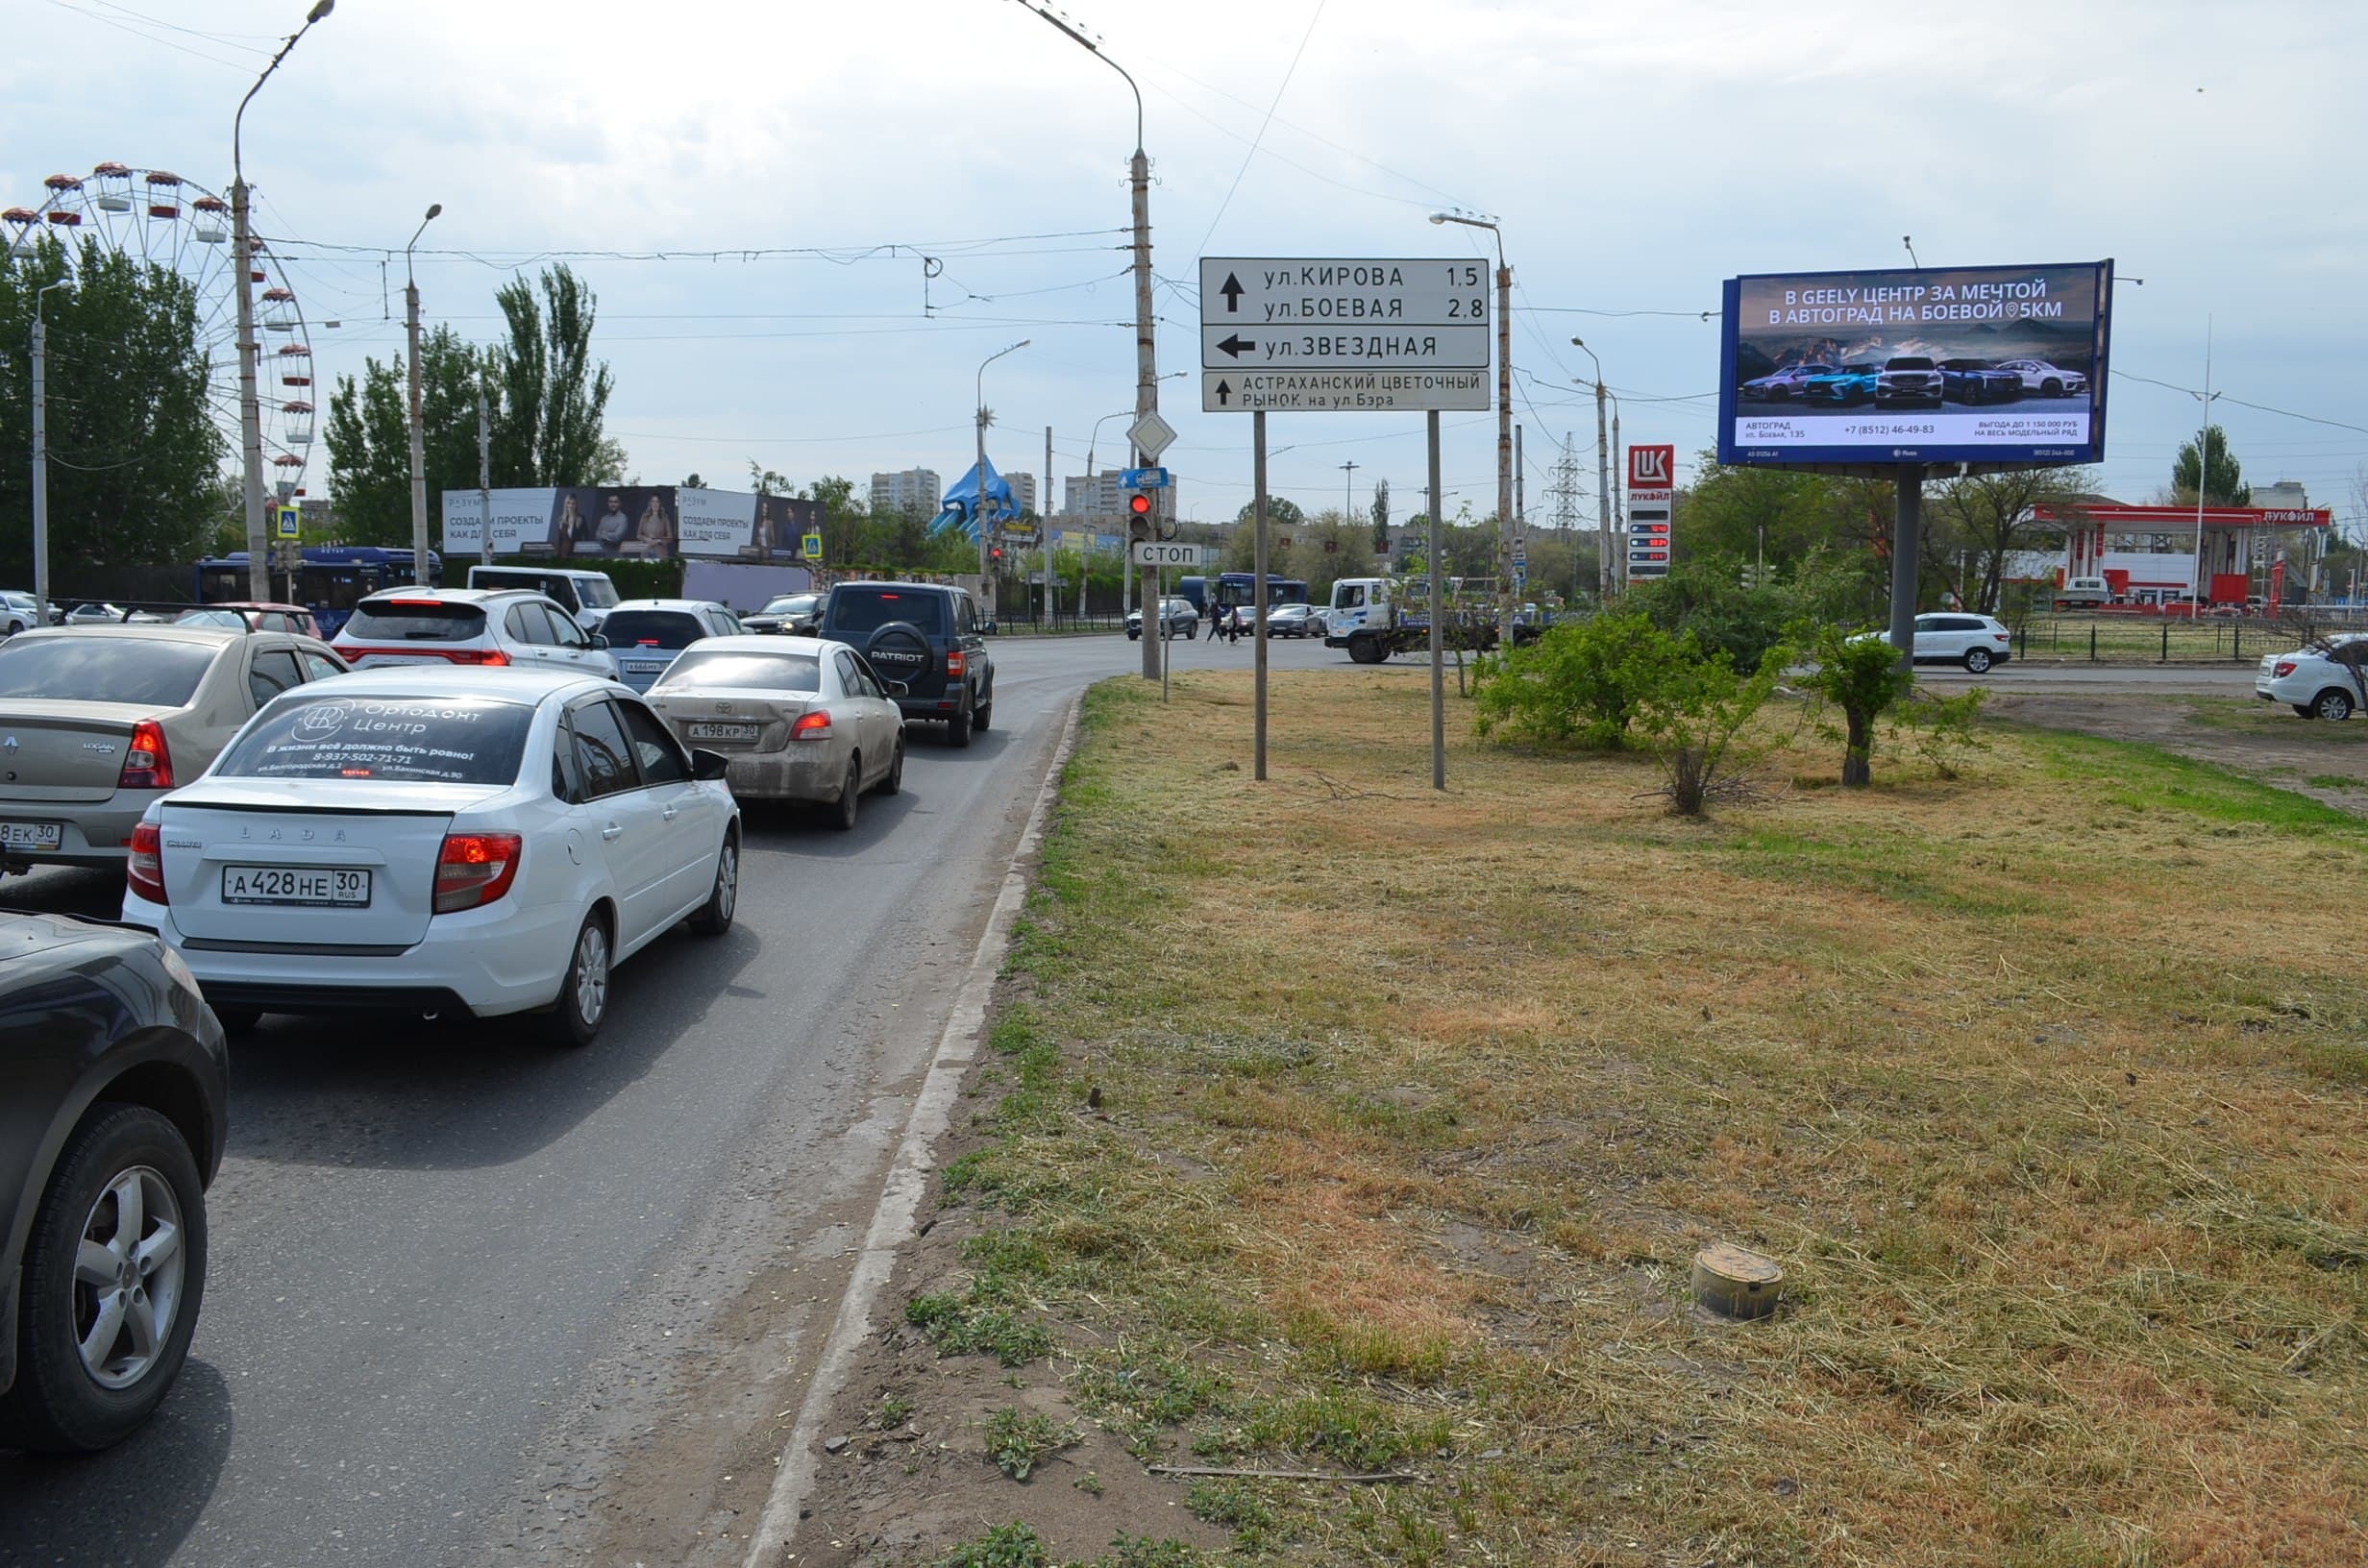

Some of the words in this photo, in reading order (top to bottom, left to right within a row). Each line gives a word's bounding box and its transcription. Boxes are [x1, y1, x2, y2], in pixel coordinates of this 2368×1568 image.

[1264, 267, 1404, 290] ул.КИРОВА
[1785, 290, 1797, 306] В
[1802, 287, 1859, 306] GEELY
[1862, 285, 1926, 306] ЦЕНТР
[1930, 284, 1959, 303] ЗА
[1962, 278, 2047, 302] МЕЧТОЙ
[1264, 298, 1403, 322] ул.БОЕВАЯ
[1769, 308, 1781, 325] В
[1785, 305, 1884, 326] АВТОГРАД
[1888, 304, 1916, 322] НА
[1921, 299, 2004, 320] БОЕВОЙ
[2019, 301, 2062, 319] 5КМ
[1265, 336, 1437, 360] ул.ЗВЕЗДНАЯ
[1243, 372, 1376, 390] АСТРАХАНСКИЙ
[1382, 372, 1480, 392] ЦВЕТОЧНЫЙ
[1243, 394, 1300, 406] РЫНОК
[1308, 396, 1326, 406] на
[1333, 396, 1351, 409] ул
[1356, 393, 1394, 409] Бэра
[1745, 422, 1791, 430] АВТОГРАД
[1844, 426, 1856, 434] +7
[1859, 425, 1889, 436] (8512)
[1891, 424, 1935, 434] 46-49-83
[2009, 429, 2060, 437] МОДЕЛЬНЫЙ
[2061, 429, 2078, 437] РЯД
[1630, 491, 1669, 501] ЛУКОЙЛ
[449, 517, 495, 527] СОЗДАМ
[497, 515, 544, 525] ПРОЕКТЫ
[2263, 509, 2315, 522] ЛУКОЙЛ
[450, 529, 469, 538] КАК
[492, 529, 517, 538] СЕБЯ
[1144, 547, 1194, 562] СТОП
[871, 650, 925, 662] PATRIOT
[364, 704, 482, 723] Ортодонт
[354, 719, 427, 735] Центр
[743, 725, 755, 735] 30
[83, 742, 115, 750] LOGAN
[266, 745, 276, 753] В
[277, 743, 317, 752] жизни
[318, 742, 341, 751] всё
[341, 743, 393, 753] должно
[394, 744, 428, 755] быть
[429, 747, 475, 761] ровно!
[312, 751, 412, 765] 8-937-502-71-71
[37, 824, 55, 839] 30
[240, 827, 346, 842] LADA
[234, 870, 328, 896] А428НЕ
[336, 872, 359, 891] 30
[338, 891, 357, 899] RUS
